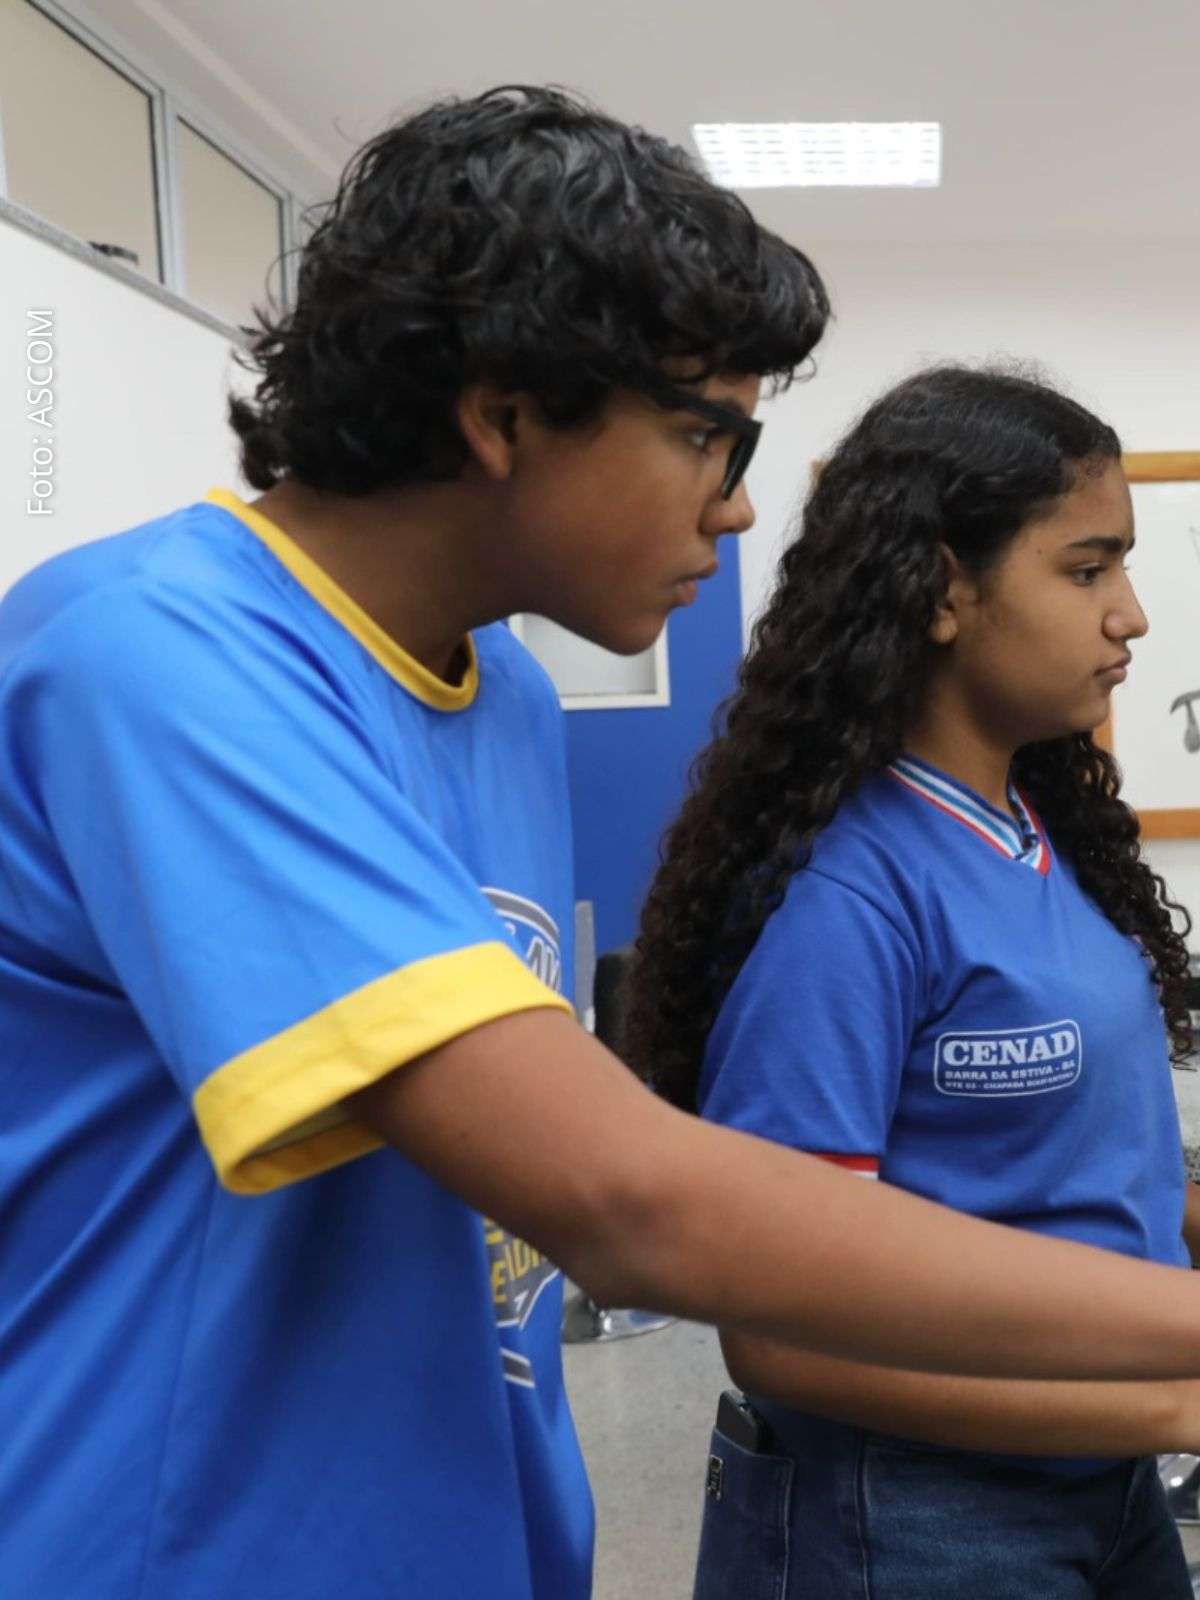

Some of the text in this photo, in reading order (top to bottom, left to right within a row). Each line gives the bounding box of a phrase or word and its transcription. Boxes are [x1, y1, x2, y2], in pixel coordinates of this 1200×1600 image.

[942, 1030, 1076, 1067] CENAD
[945, 1070, 988, 1081] BARRA
[991, 1070, 1008, 1080] DA
[1011, 1065, 1054, 1080] ESTIVA
